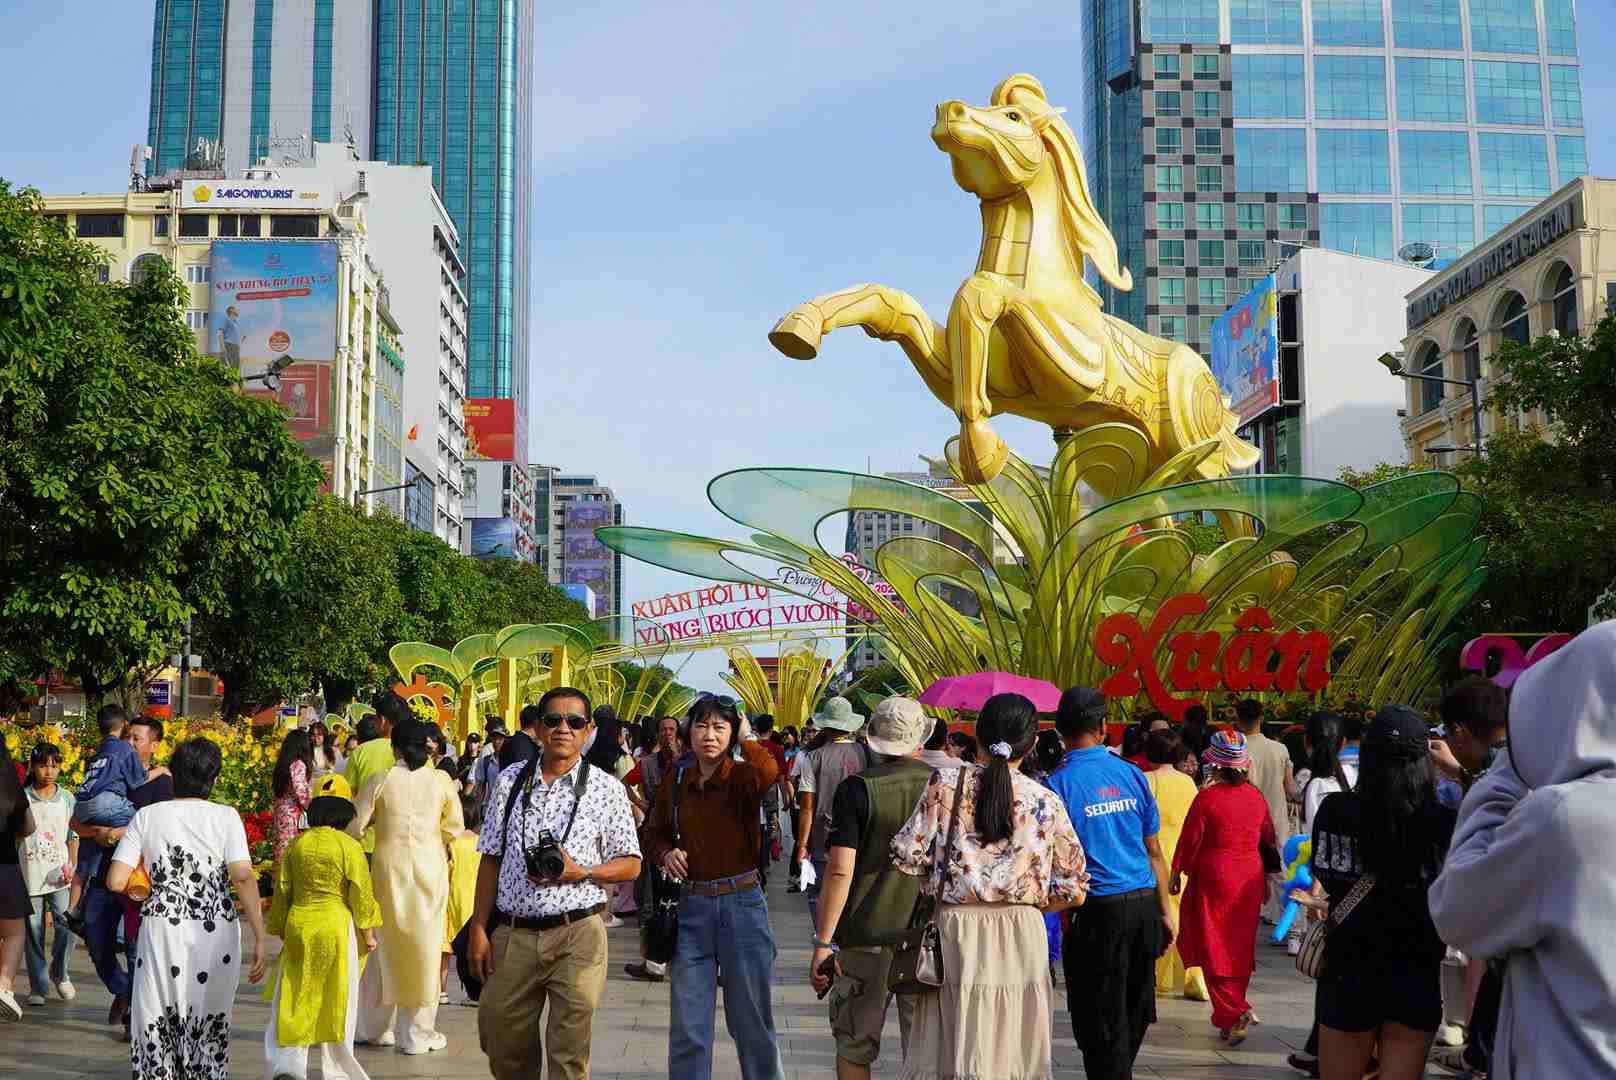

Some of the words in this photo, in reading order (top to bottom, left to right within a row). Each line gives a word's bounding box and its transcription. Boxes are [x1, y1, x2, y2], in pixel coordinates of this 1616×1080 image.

[216, 188, 294, 199] SAIGONTOURIST
[1520, 202, 1573, 257] SAIGON
[874, 583, 895, 594] 202
[632, 592, 692, 619] XUÂN
[1095, 592, 1330, 722] Xuân
[1084, 798, 1137, 817] SECURITY
